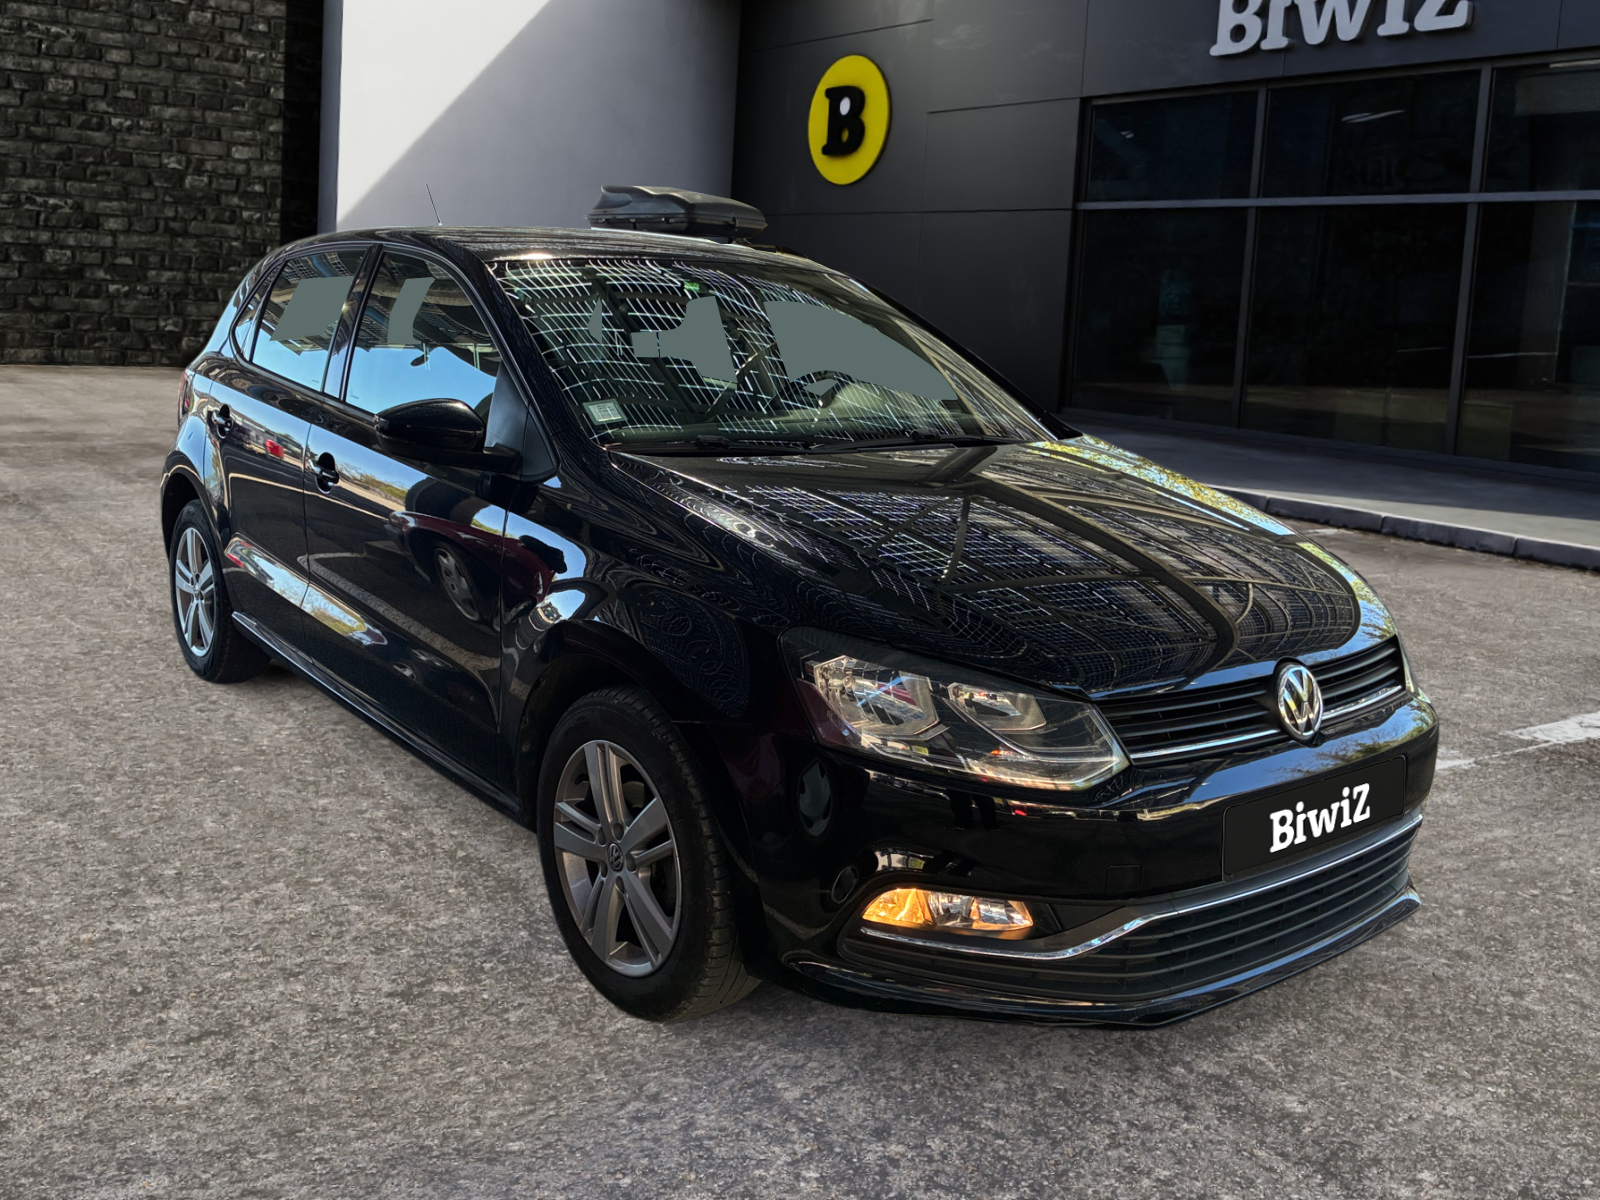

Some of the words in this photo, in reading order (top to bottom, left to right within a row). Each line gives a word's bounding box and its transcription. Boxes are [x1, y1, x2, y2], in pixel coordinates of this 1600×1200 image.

[821, 84, 867, 157] B
[1278, 663, 1323, 737] VW
[1269, 783, 1371, 853] BiwiZ
